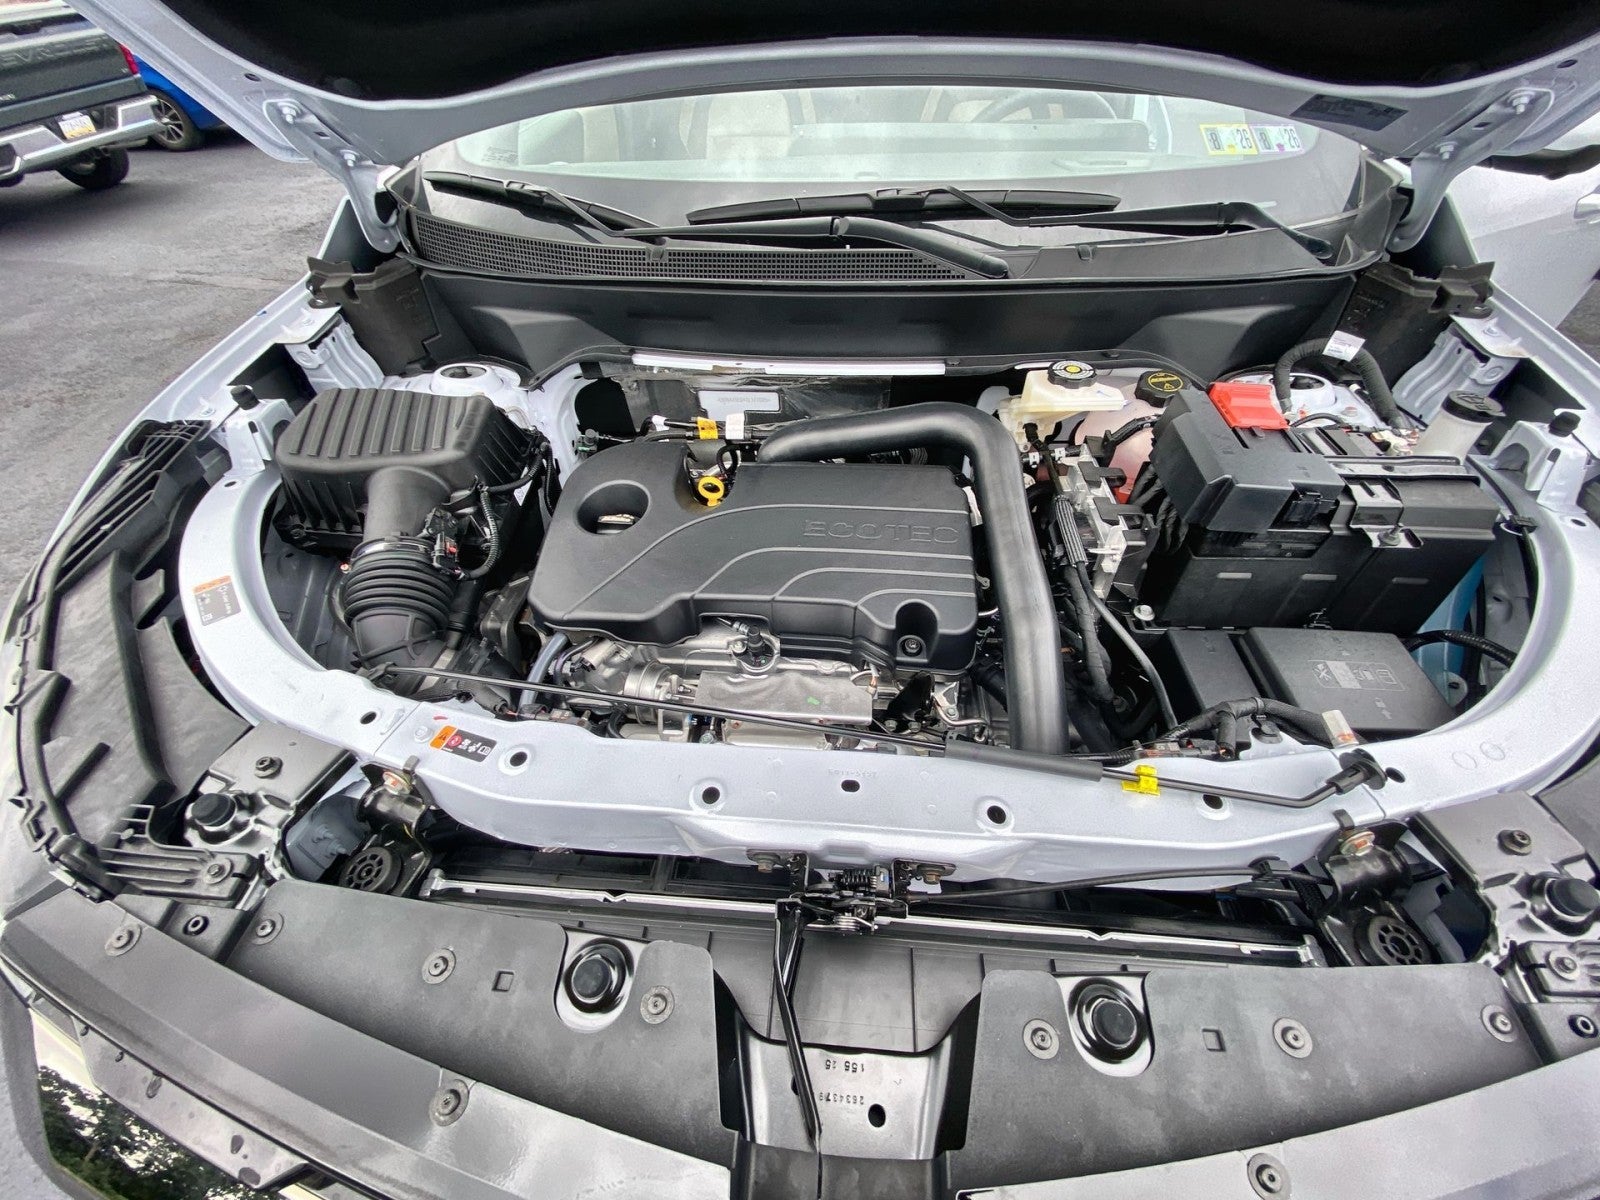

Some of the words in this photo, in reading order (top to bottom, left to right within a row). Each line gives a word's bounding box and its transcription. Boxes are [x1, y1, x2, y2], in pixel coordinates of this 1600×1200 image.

[1236, 128, 1252, 149] 26
[1284, 128, 1300, 148] 26
[803, 519, 959, 544] ECOTEC
